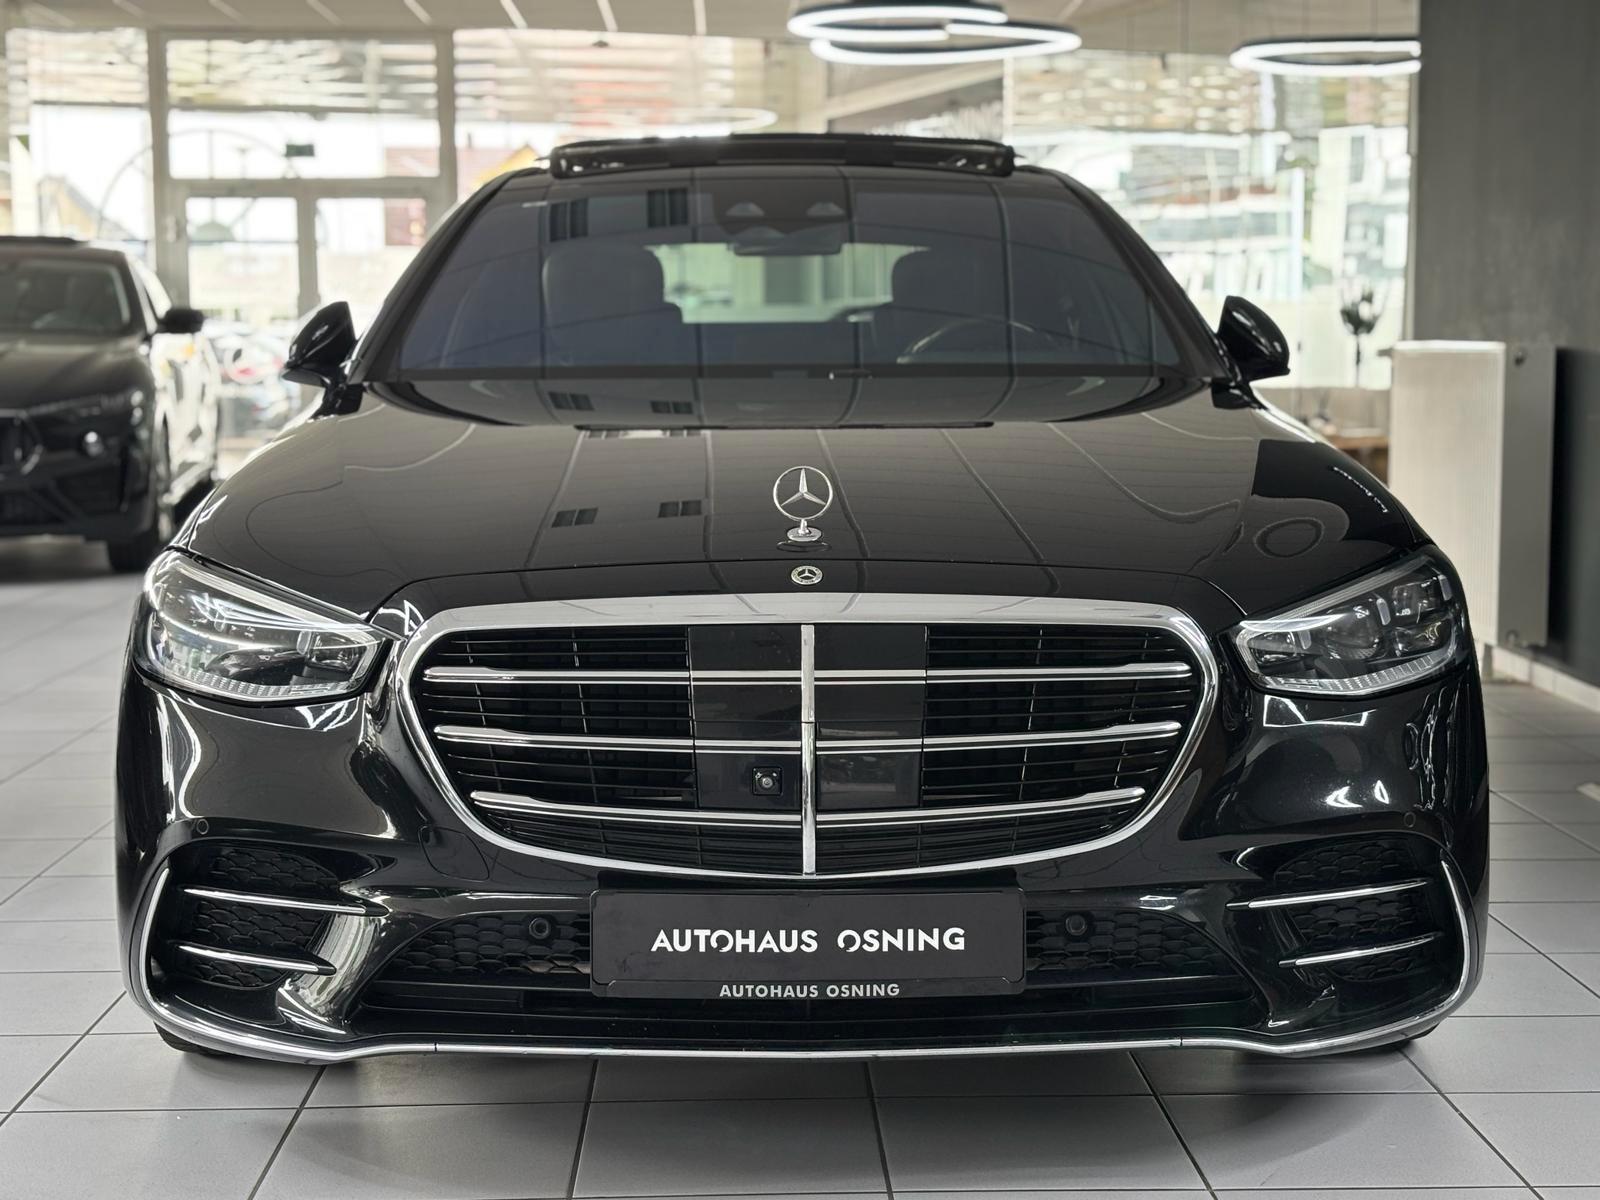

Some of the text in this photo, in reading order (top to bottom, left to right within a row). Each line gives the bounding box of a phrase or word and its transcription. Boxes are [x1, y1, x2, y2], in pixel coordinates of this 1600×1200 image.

[650, 926, 966, 953] AUTOHAUS OSNING
[719, 983, 901, 998] AUTOHAUS OSNING
